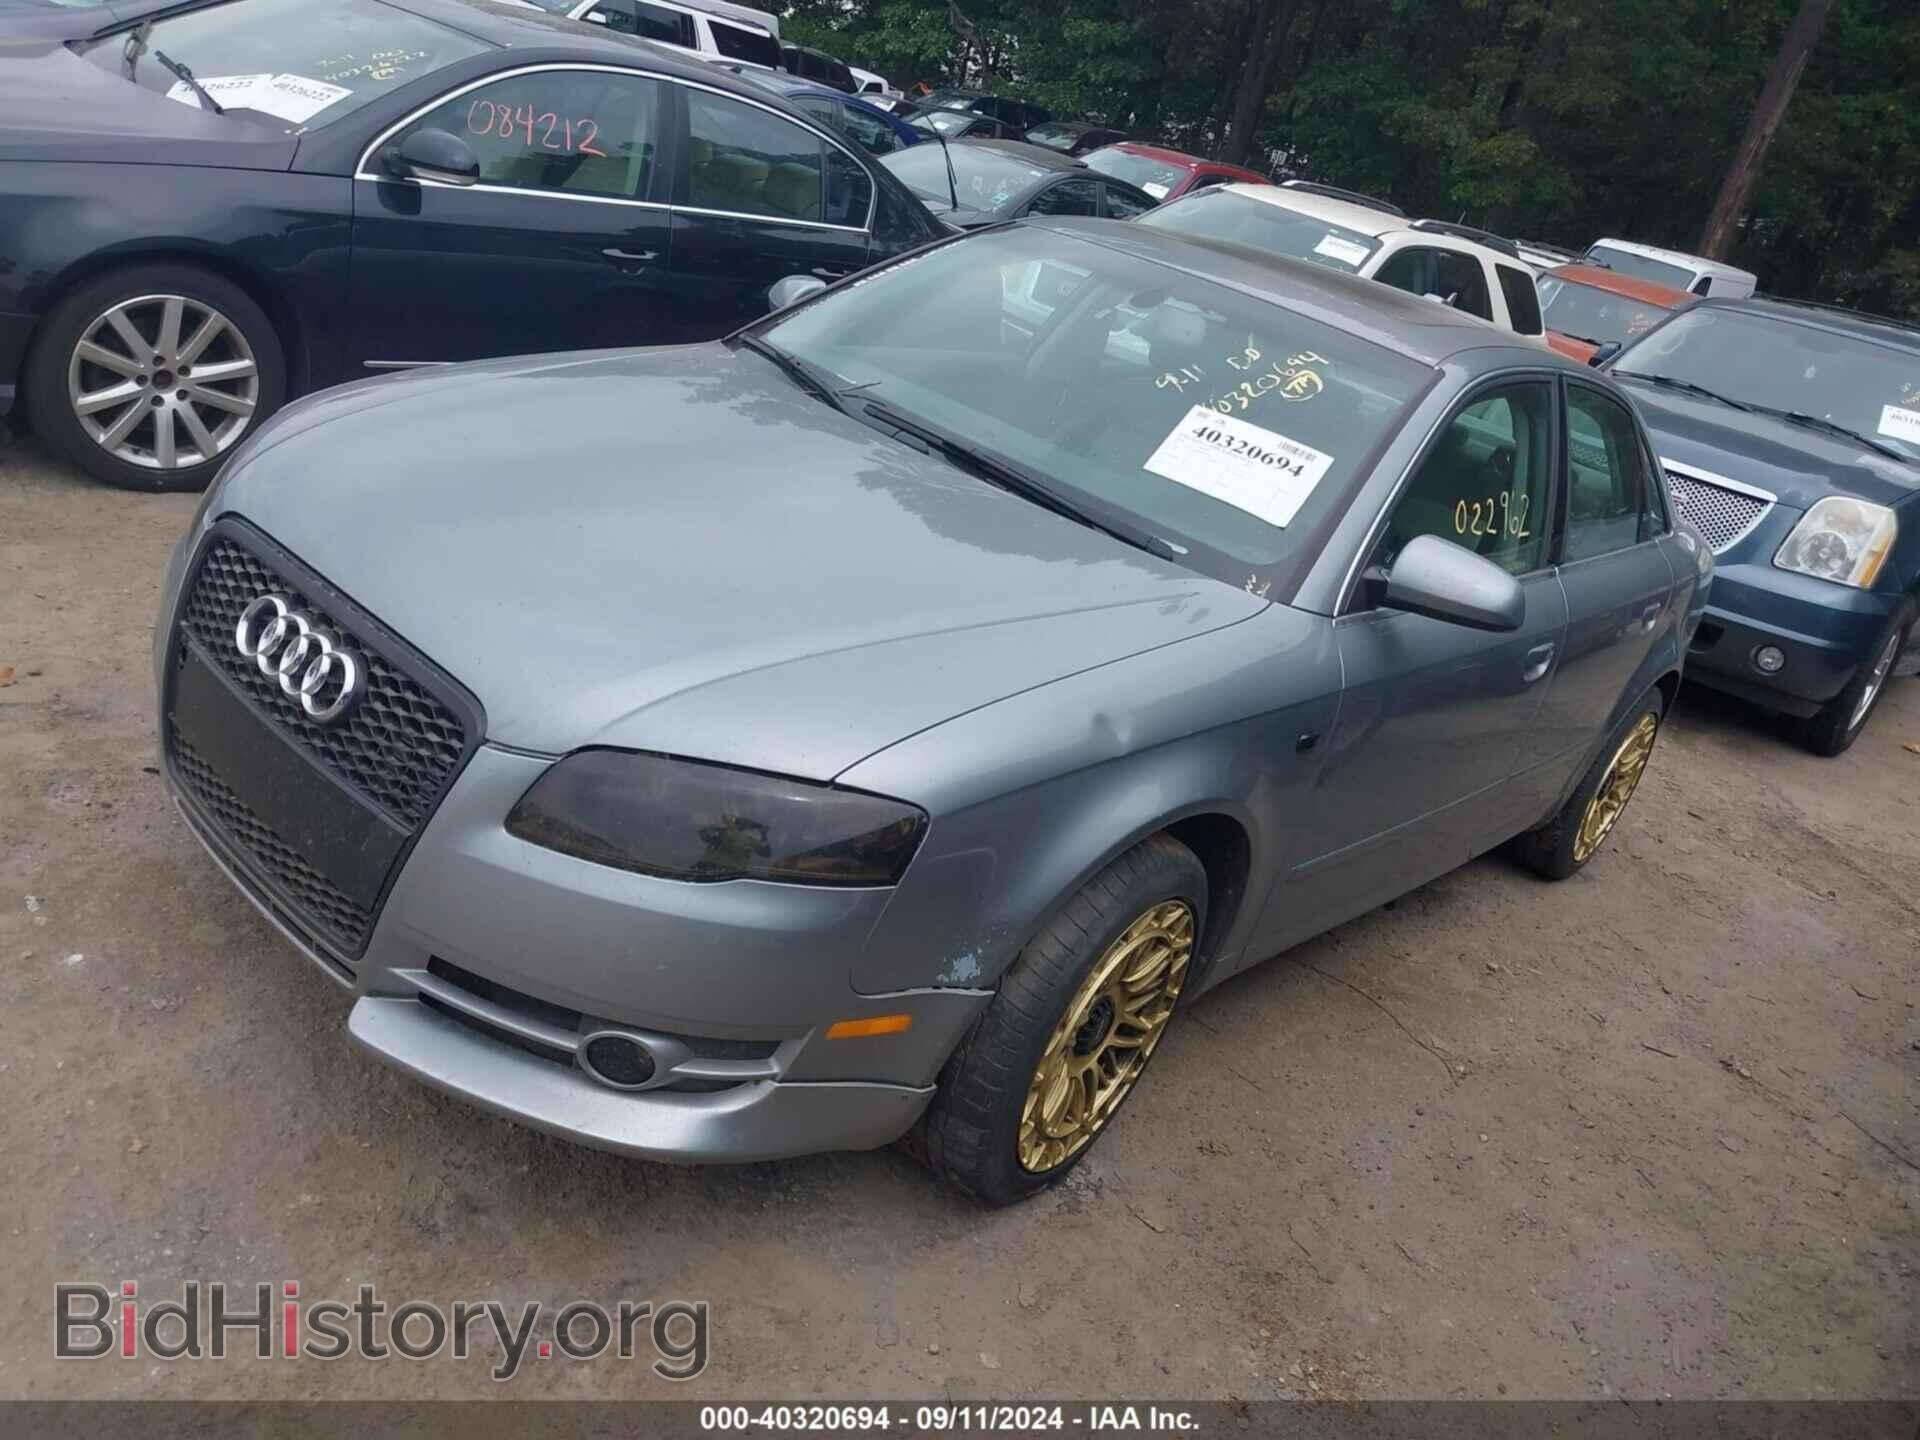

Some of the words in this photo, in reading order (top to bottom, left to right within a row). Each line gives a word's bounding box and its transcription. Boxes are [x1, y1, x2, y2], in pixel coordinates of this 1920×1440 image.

[467, 100, 607, 158] 084212
[1192, 425, 1306, 478] 40320694
[1455, 491, 1530, 539] 022962
